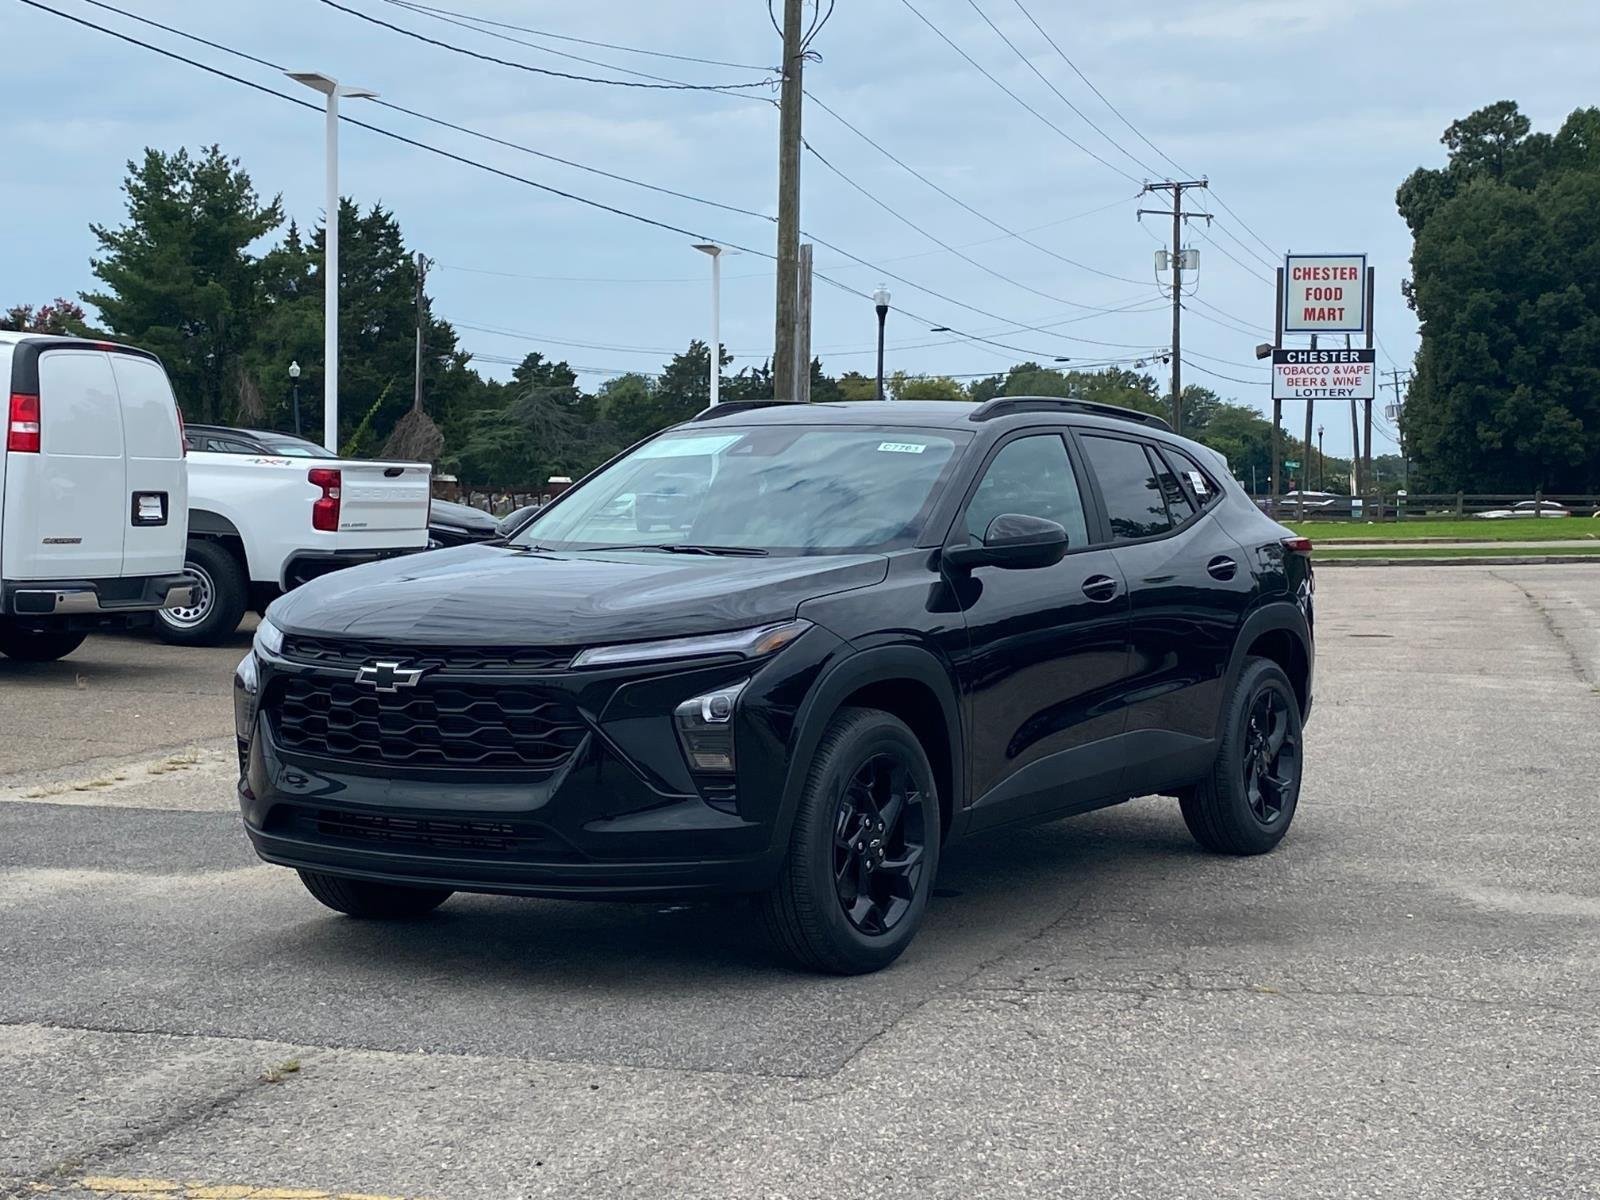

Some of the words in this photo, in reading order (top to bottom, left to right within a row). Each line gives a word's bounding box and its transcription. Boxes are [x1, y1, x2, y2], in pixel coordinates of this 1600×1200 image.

[1292, 266, 1358, 281] CHESTER
[1305, 287, 1343, 301] FOOD
[1303, 307, 1345, 321] MART
[1286, 351, 1360, 363] CHESTER
[1277, 366, 1330, 376] TOBACCO
[1342, 365, 1371, 375] VAPE
[1286, 377, 1318, 387] BEER
[1332, 376, 1362, 386] WINE
[1295, 388, 1355, 397] LOTTERY
